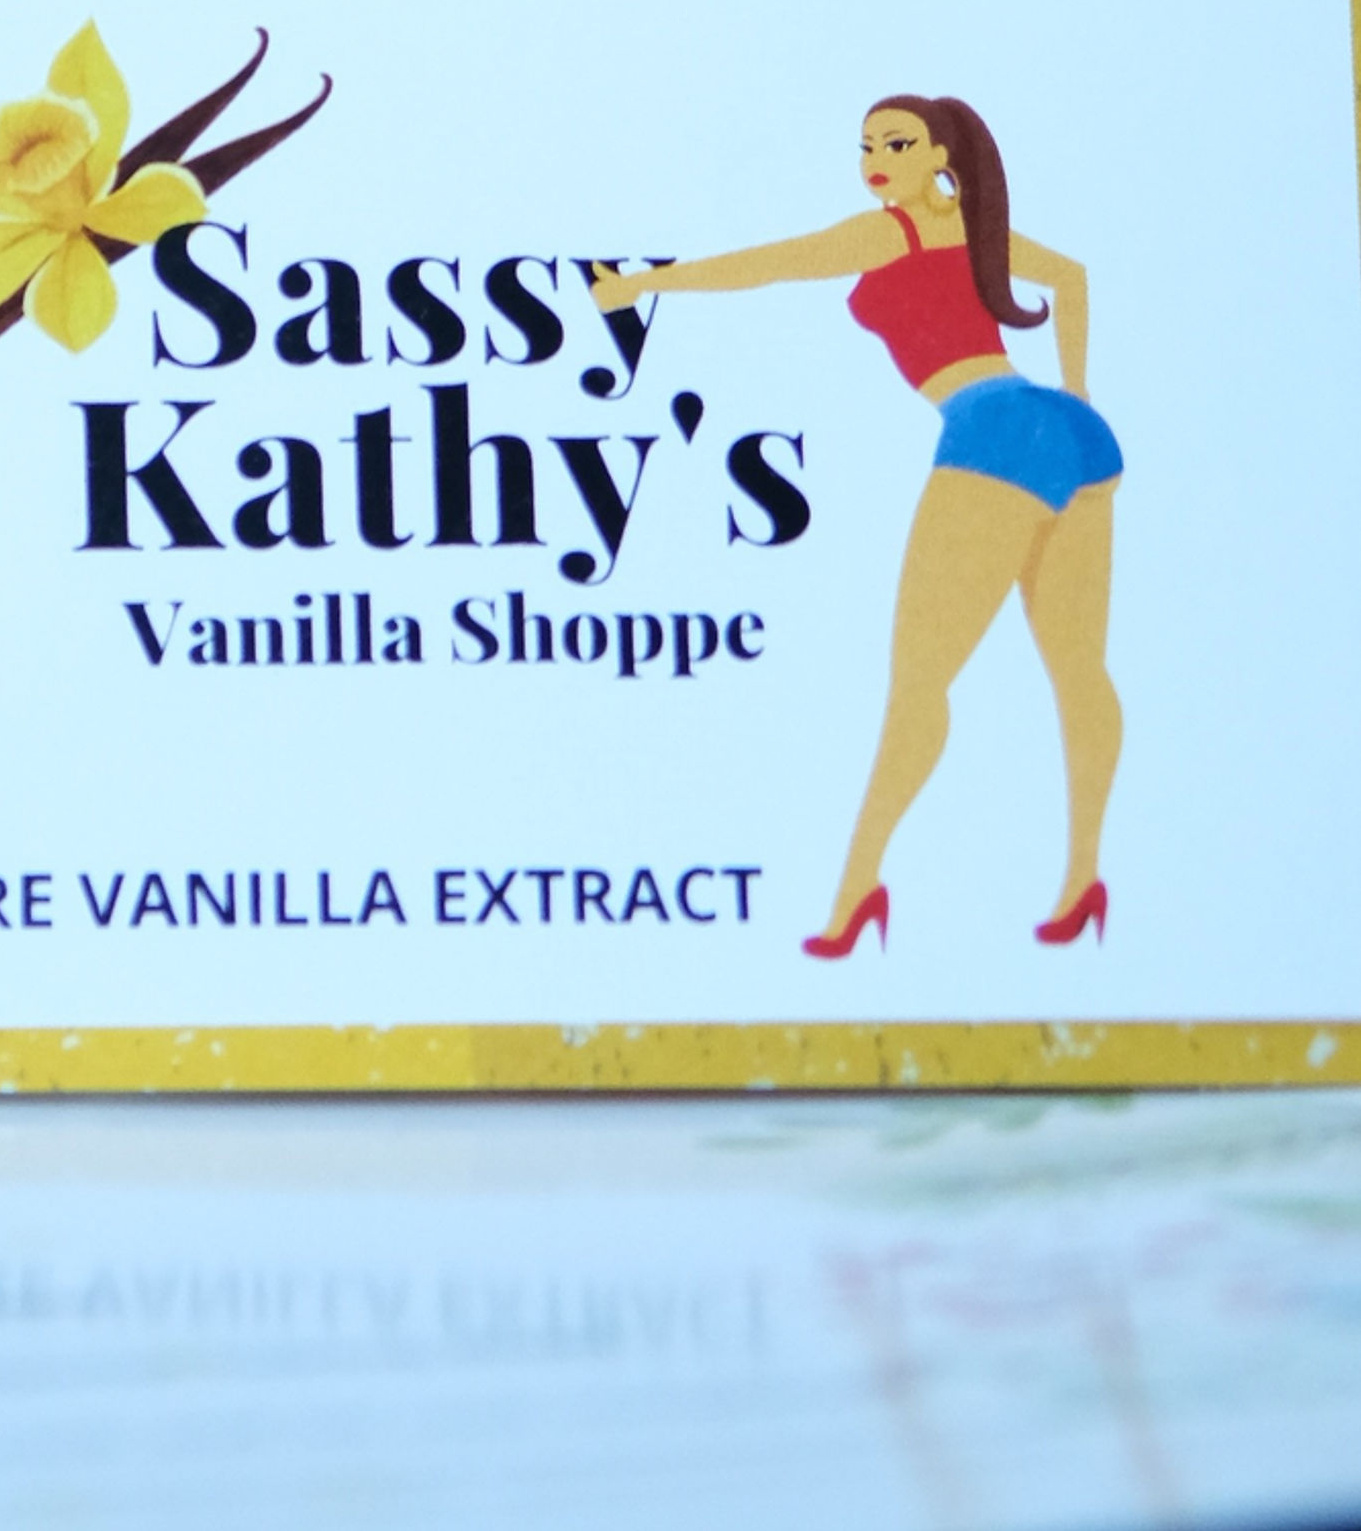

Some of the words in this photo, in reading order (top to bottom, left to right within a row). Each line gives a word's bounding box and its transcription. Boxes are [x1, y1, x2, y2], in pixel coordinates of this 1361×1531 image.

[152, 220, 677, 400] Sassy
[69, 383, 813, 585] Kathy's
[124, 593, 426, 668] Vanilla
[449, 591, 767, 678] Shoppe
[79, 868, 407, 928] VANILLA
[434, 866, 765, 925] EXTRACT
